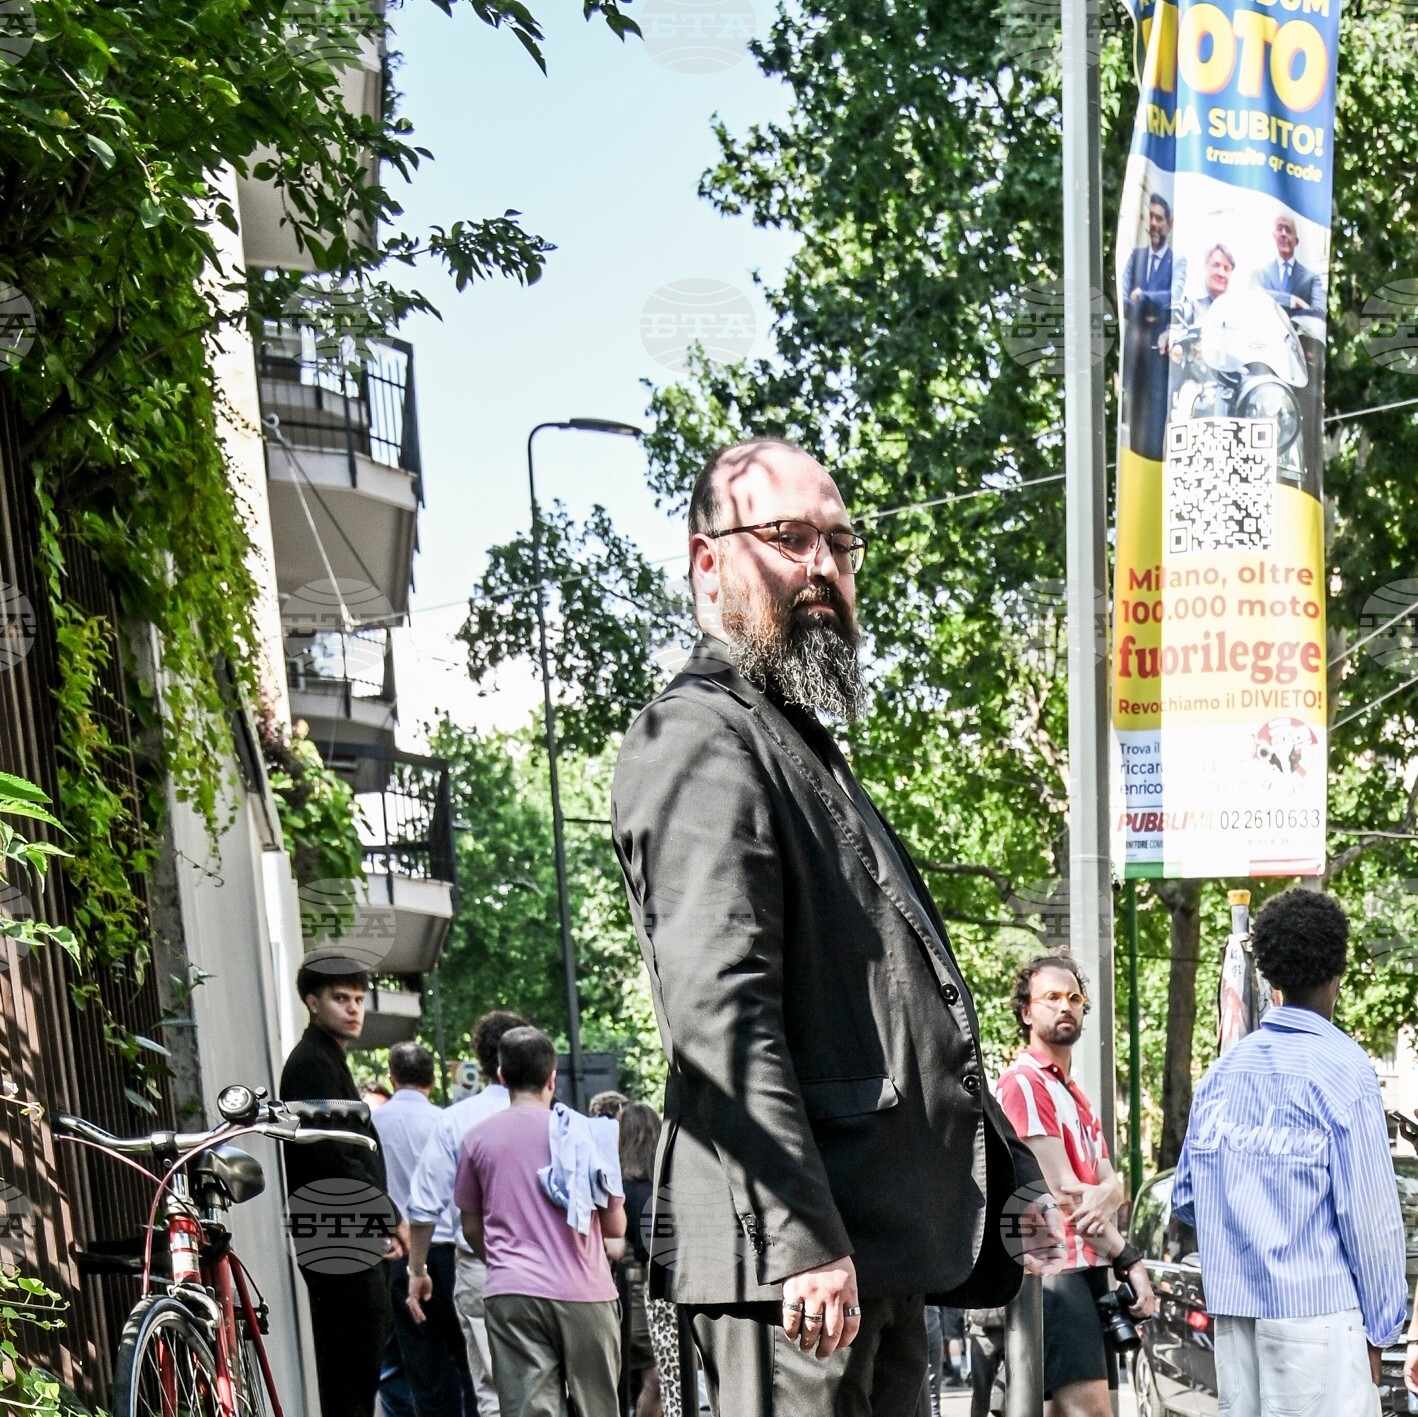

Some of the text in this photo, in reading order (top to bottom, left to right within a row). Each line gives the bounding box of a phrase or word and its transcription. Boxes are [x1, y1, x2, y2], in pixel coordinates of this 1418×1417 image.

[1208, 107, 1325, 157] SUBITO!
[1206, 145, 1323, 183] tramite qr code
[1128, 561, 1314, 592] Milano, oltre
[1122, 595, 1320, 625] 100.000 moto
[1118, 630, 1321, 685] fuorilegge
[1118, 689, 1322, 715] Revochiamo il DIVIETO!
